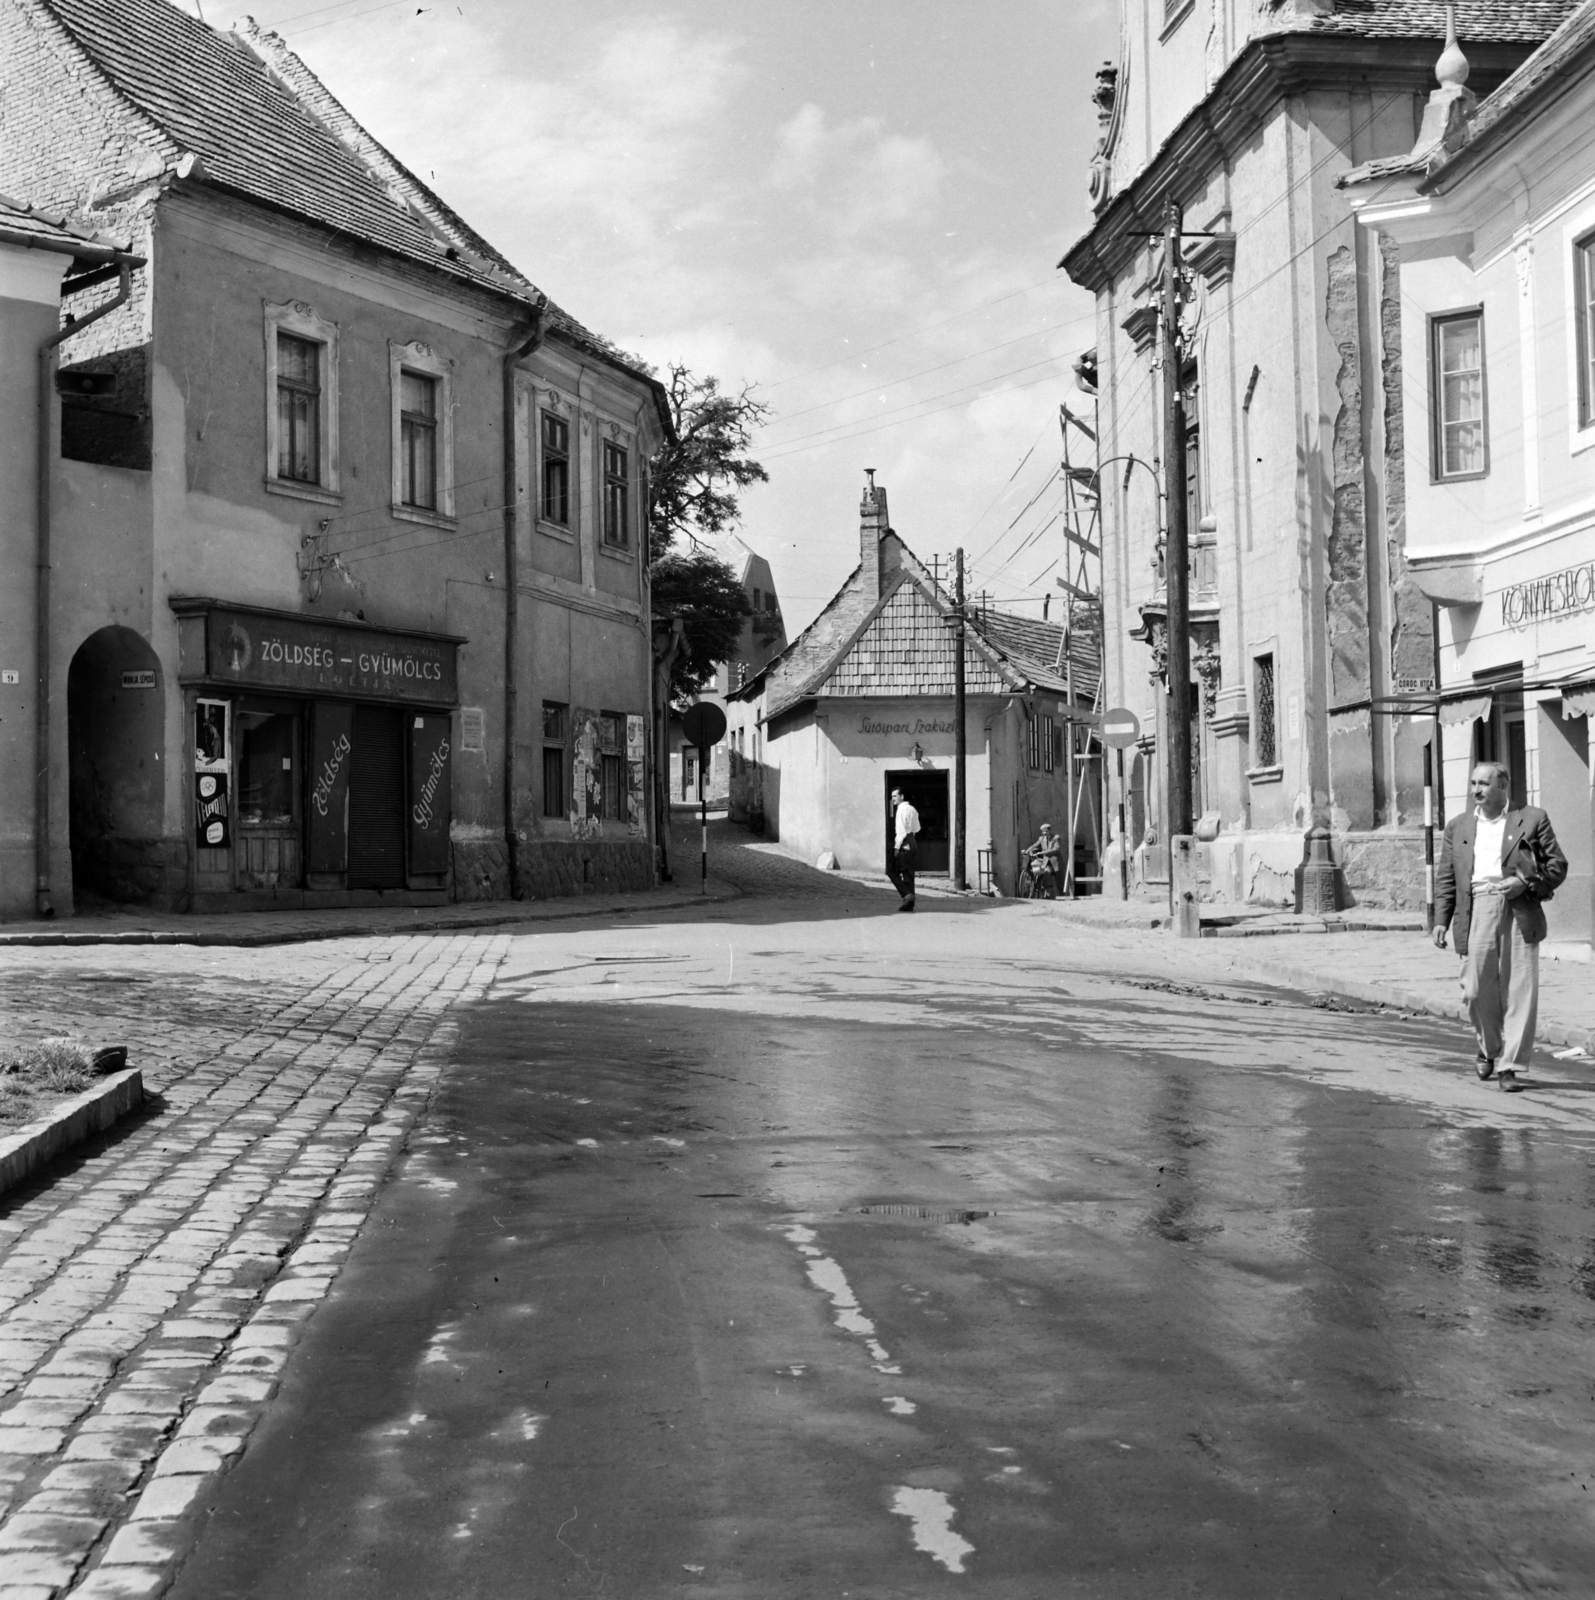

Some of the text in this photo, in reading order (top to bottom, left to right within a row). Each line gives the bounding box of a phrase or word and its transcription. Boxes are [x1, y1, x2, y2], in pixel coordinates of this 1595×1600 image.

[261, 638, 334, 668] ZÖLDSÉG
[359, 652, 441, 681] GYÜMÖLCS
[312, 733, 351, 816] Zöldség
[413, 738, 450, 830] Gyümölcs
